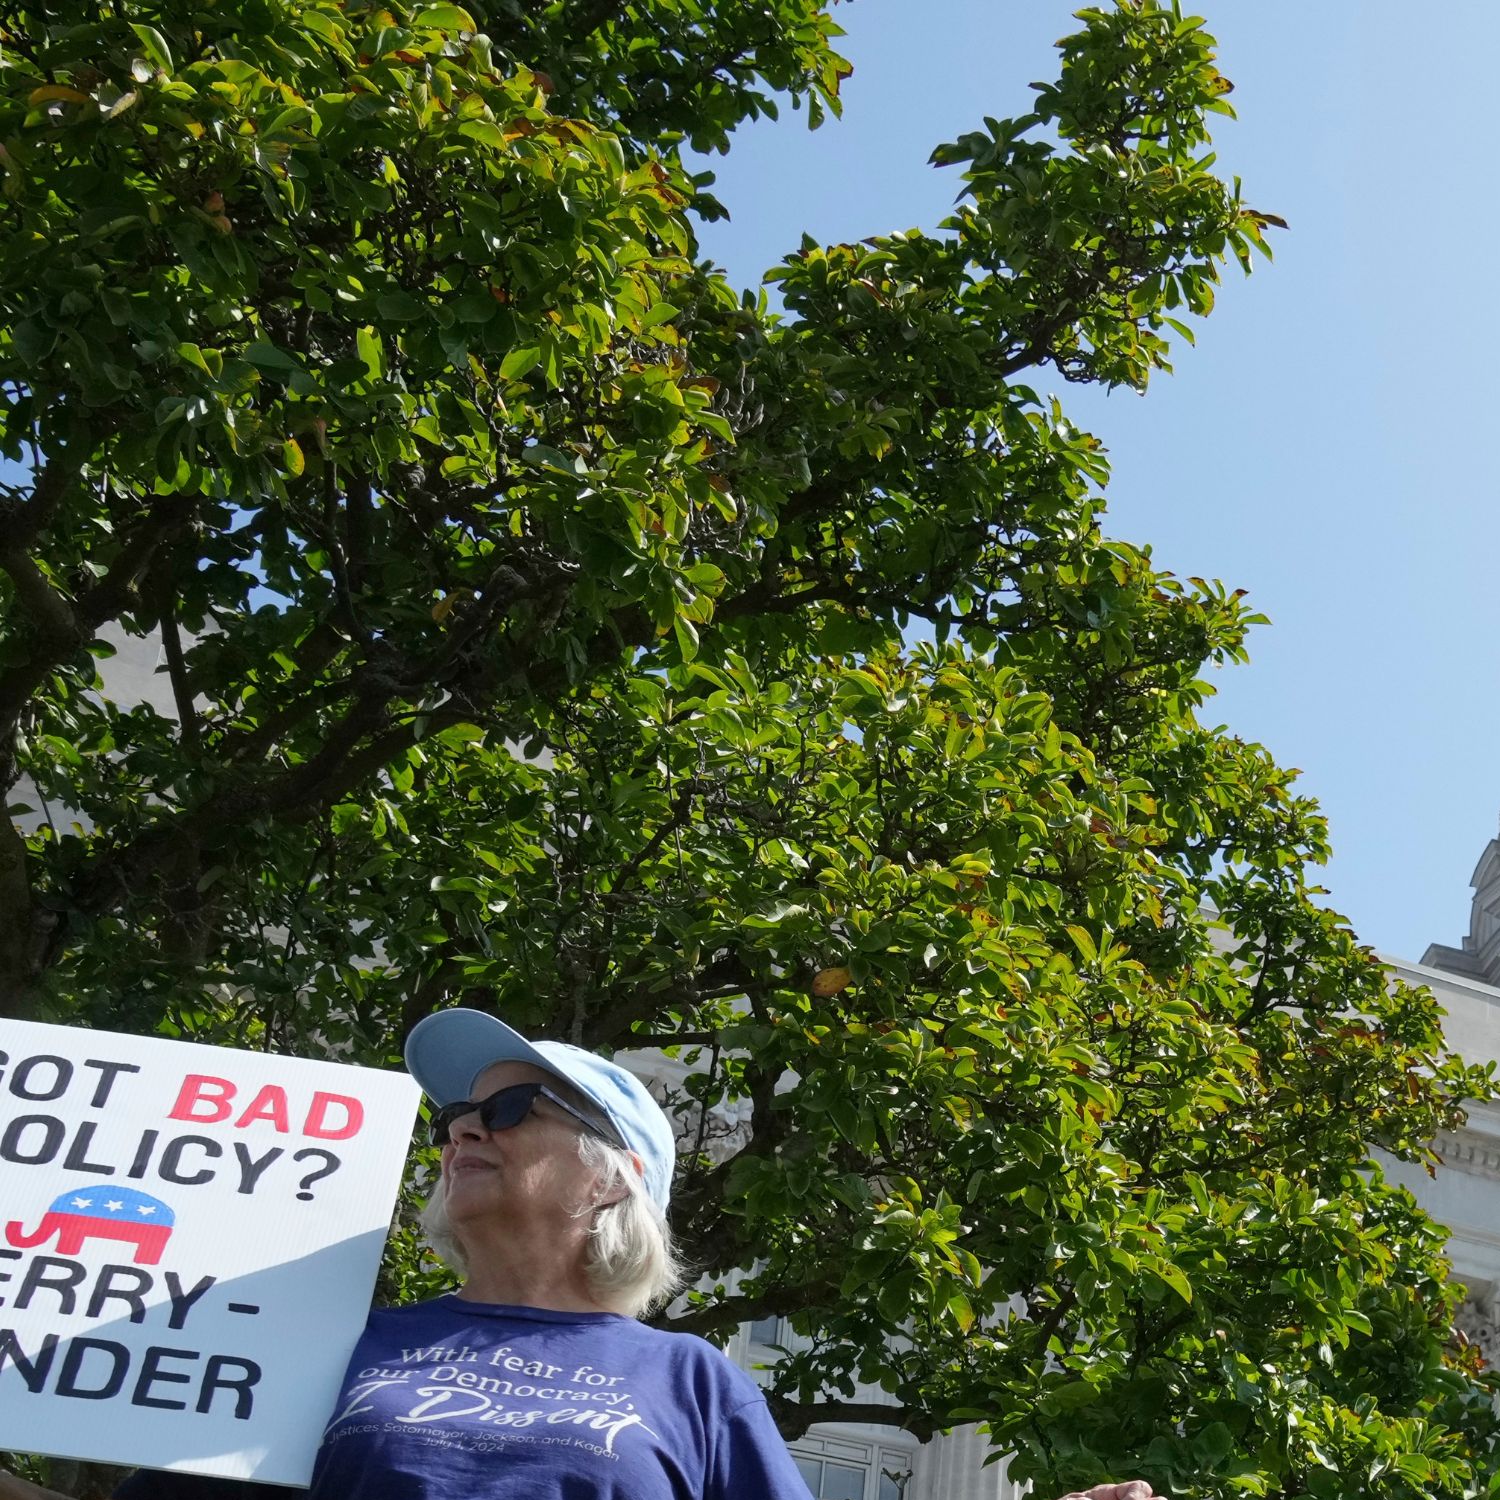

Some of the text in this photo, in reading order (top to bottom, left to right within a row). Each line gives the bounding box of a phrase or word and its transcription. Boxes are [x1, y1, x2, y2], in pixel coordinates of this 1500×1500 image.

[167, 1073, 365, 1141] BAD
[358, 1365, 634, 1410] our Democracy,
[401, 1347, 624, 1388] With fear for
[396, 1386, 660, 1453] Dissent
[468, 1441, 505, 1453] 2024
[542, 1436, 571, 1447] and
[574, 1437, 621, 1461] Kagan
